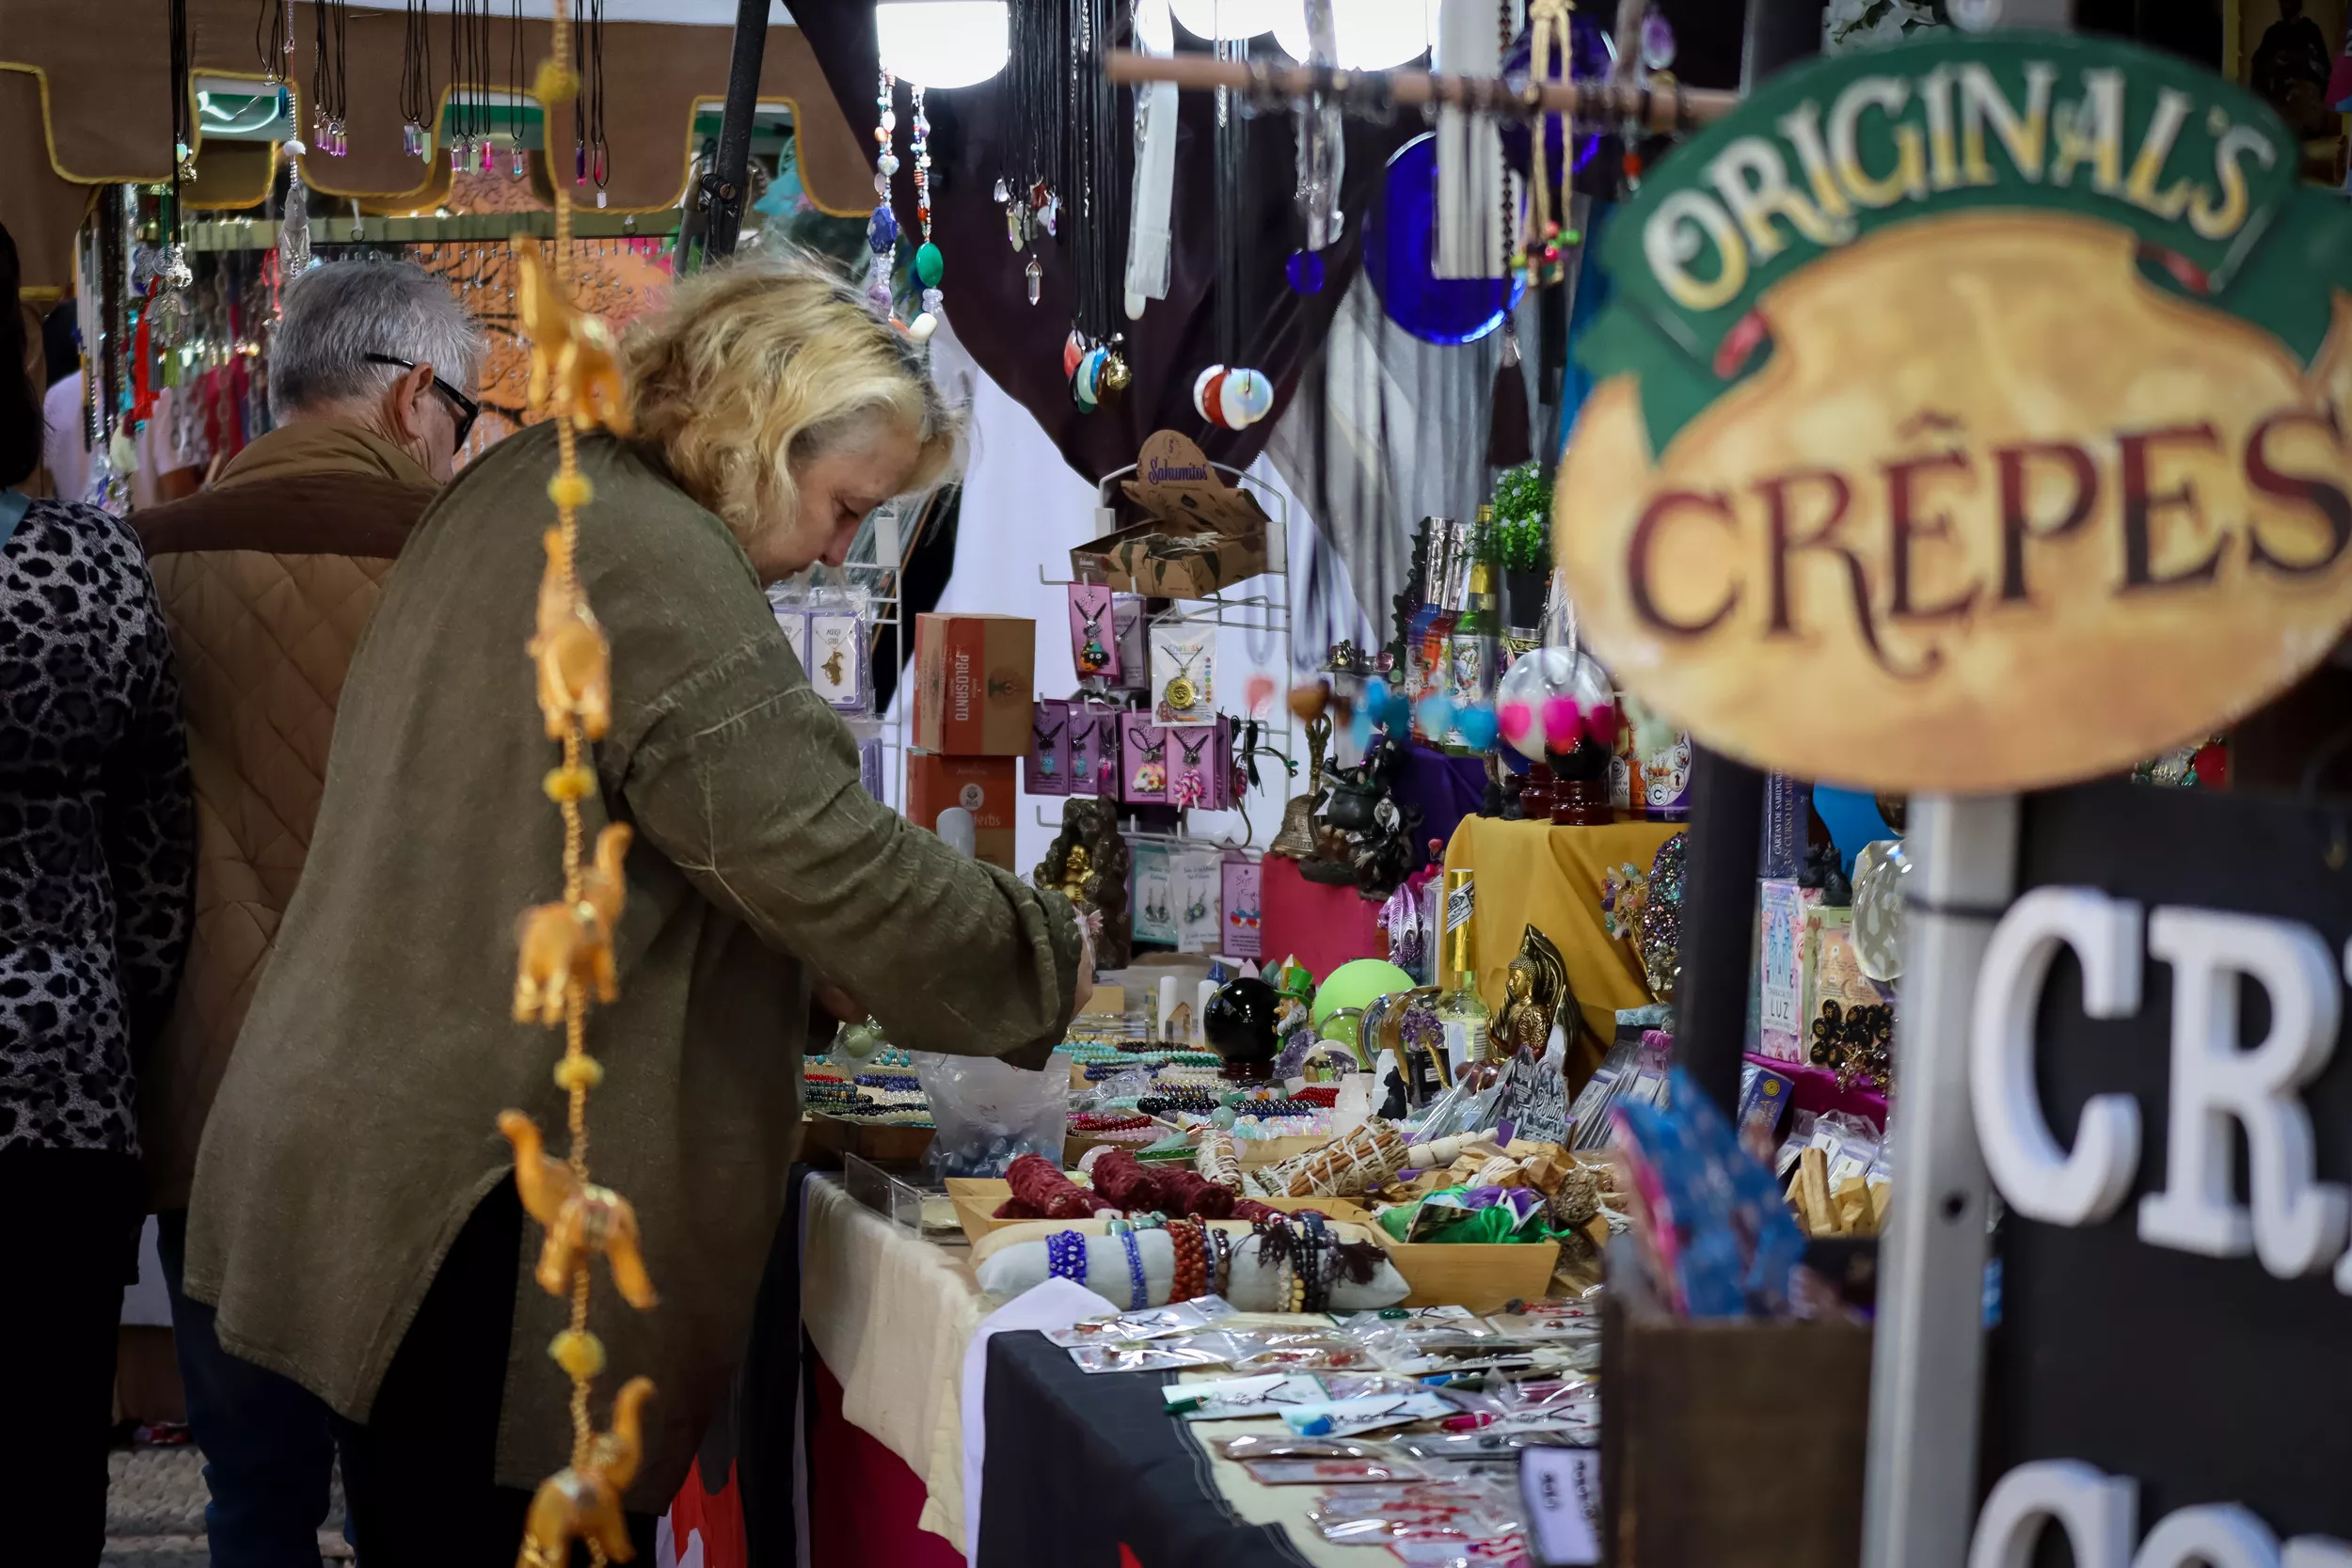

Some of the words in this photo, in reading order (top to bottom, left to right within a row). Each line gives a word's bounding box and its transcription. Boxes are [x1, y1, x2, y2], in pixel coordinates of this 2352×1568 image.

[1643, 60, 2278, 310] ORIGINAL'S
[1149, 456, 1208, 484] Sahumitos
[1626, 399, 2352, 681] CRÊPES
[1770, 998, 1789, 1020] LUZ
[1968, 884, 2352, 1294] CR
